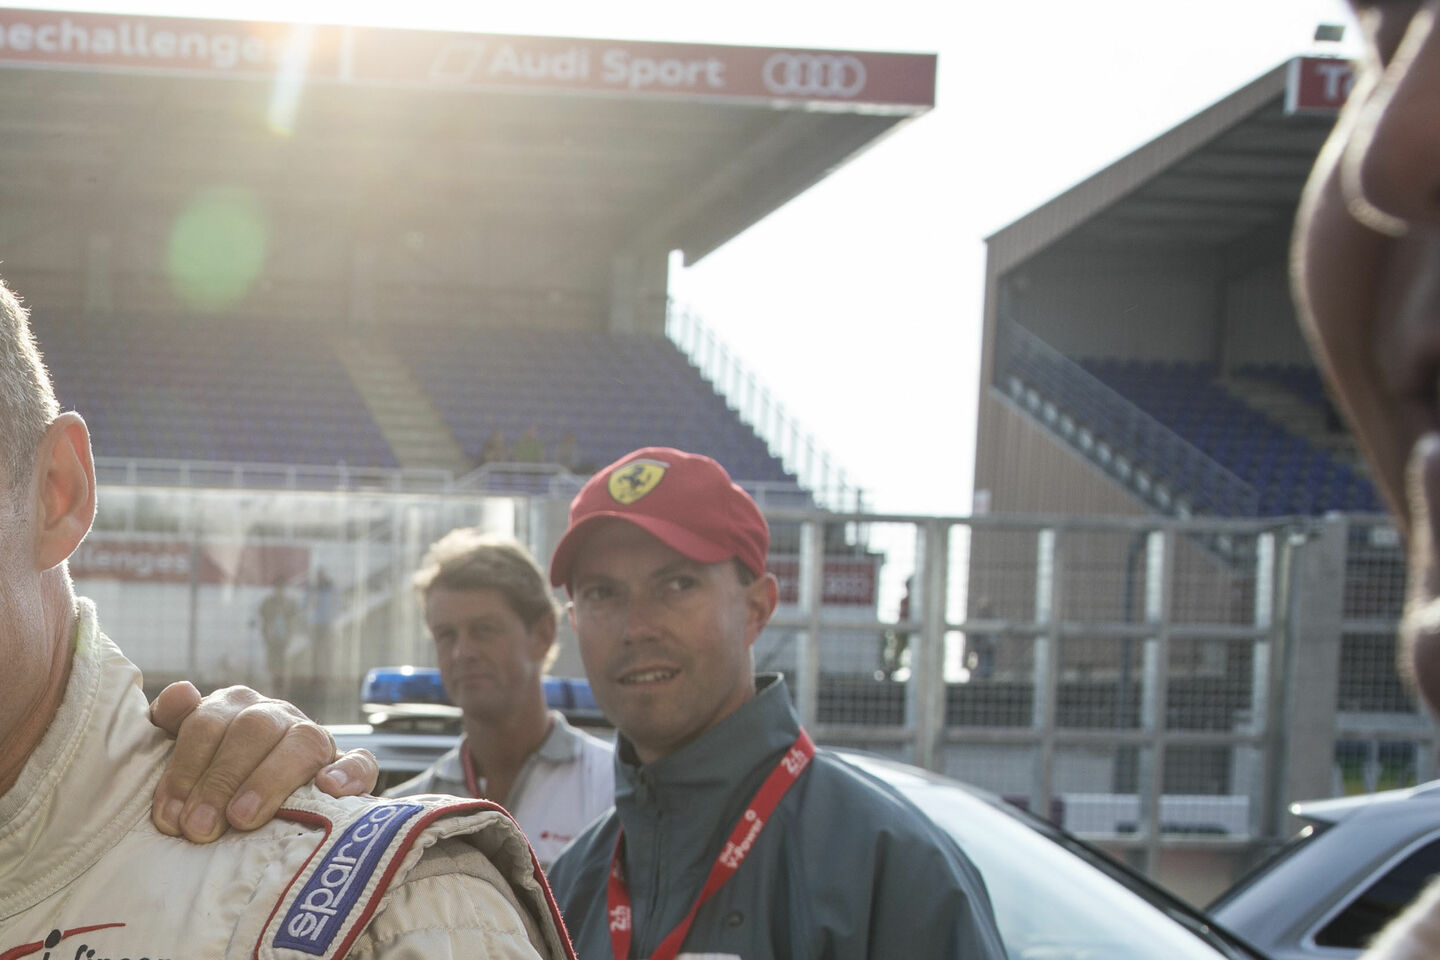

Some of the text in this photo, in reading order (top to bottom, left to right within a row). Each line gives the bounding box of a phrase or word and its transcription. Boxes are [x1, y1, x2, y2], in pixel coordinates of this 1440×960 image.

[488, 44, 726, 89] Audi Sport
[288, 805, 403, 941] sparco
